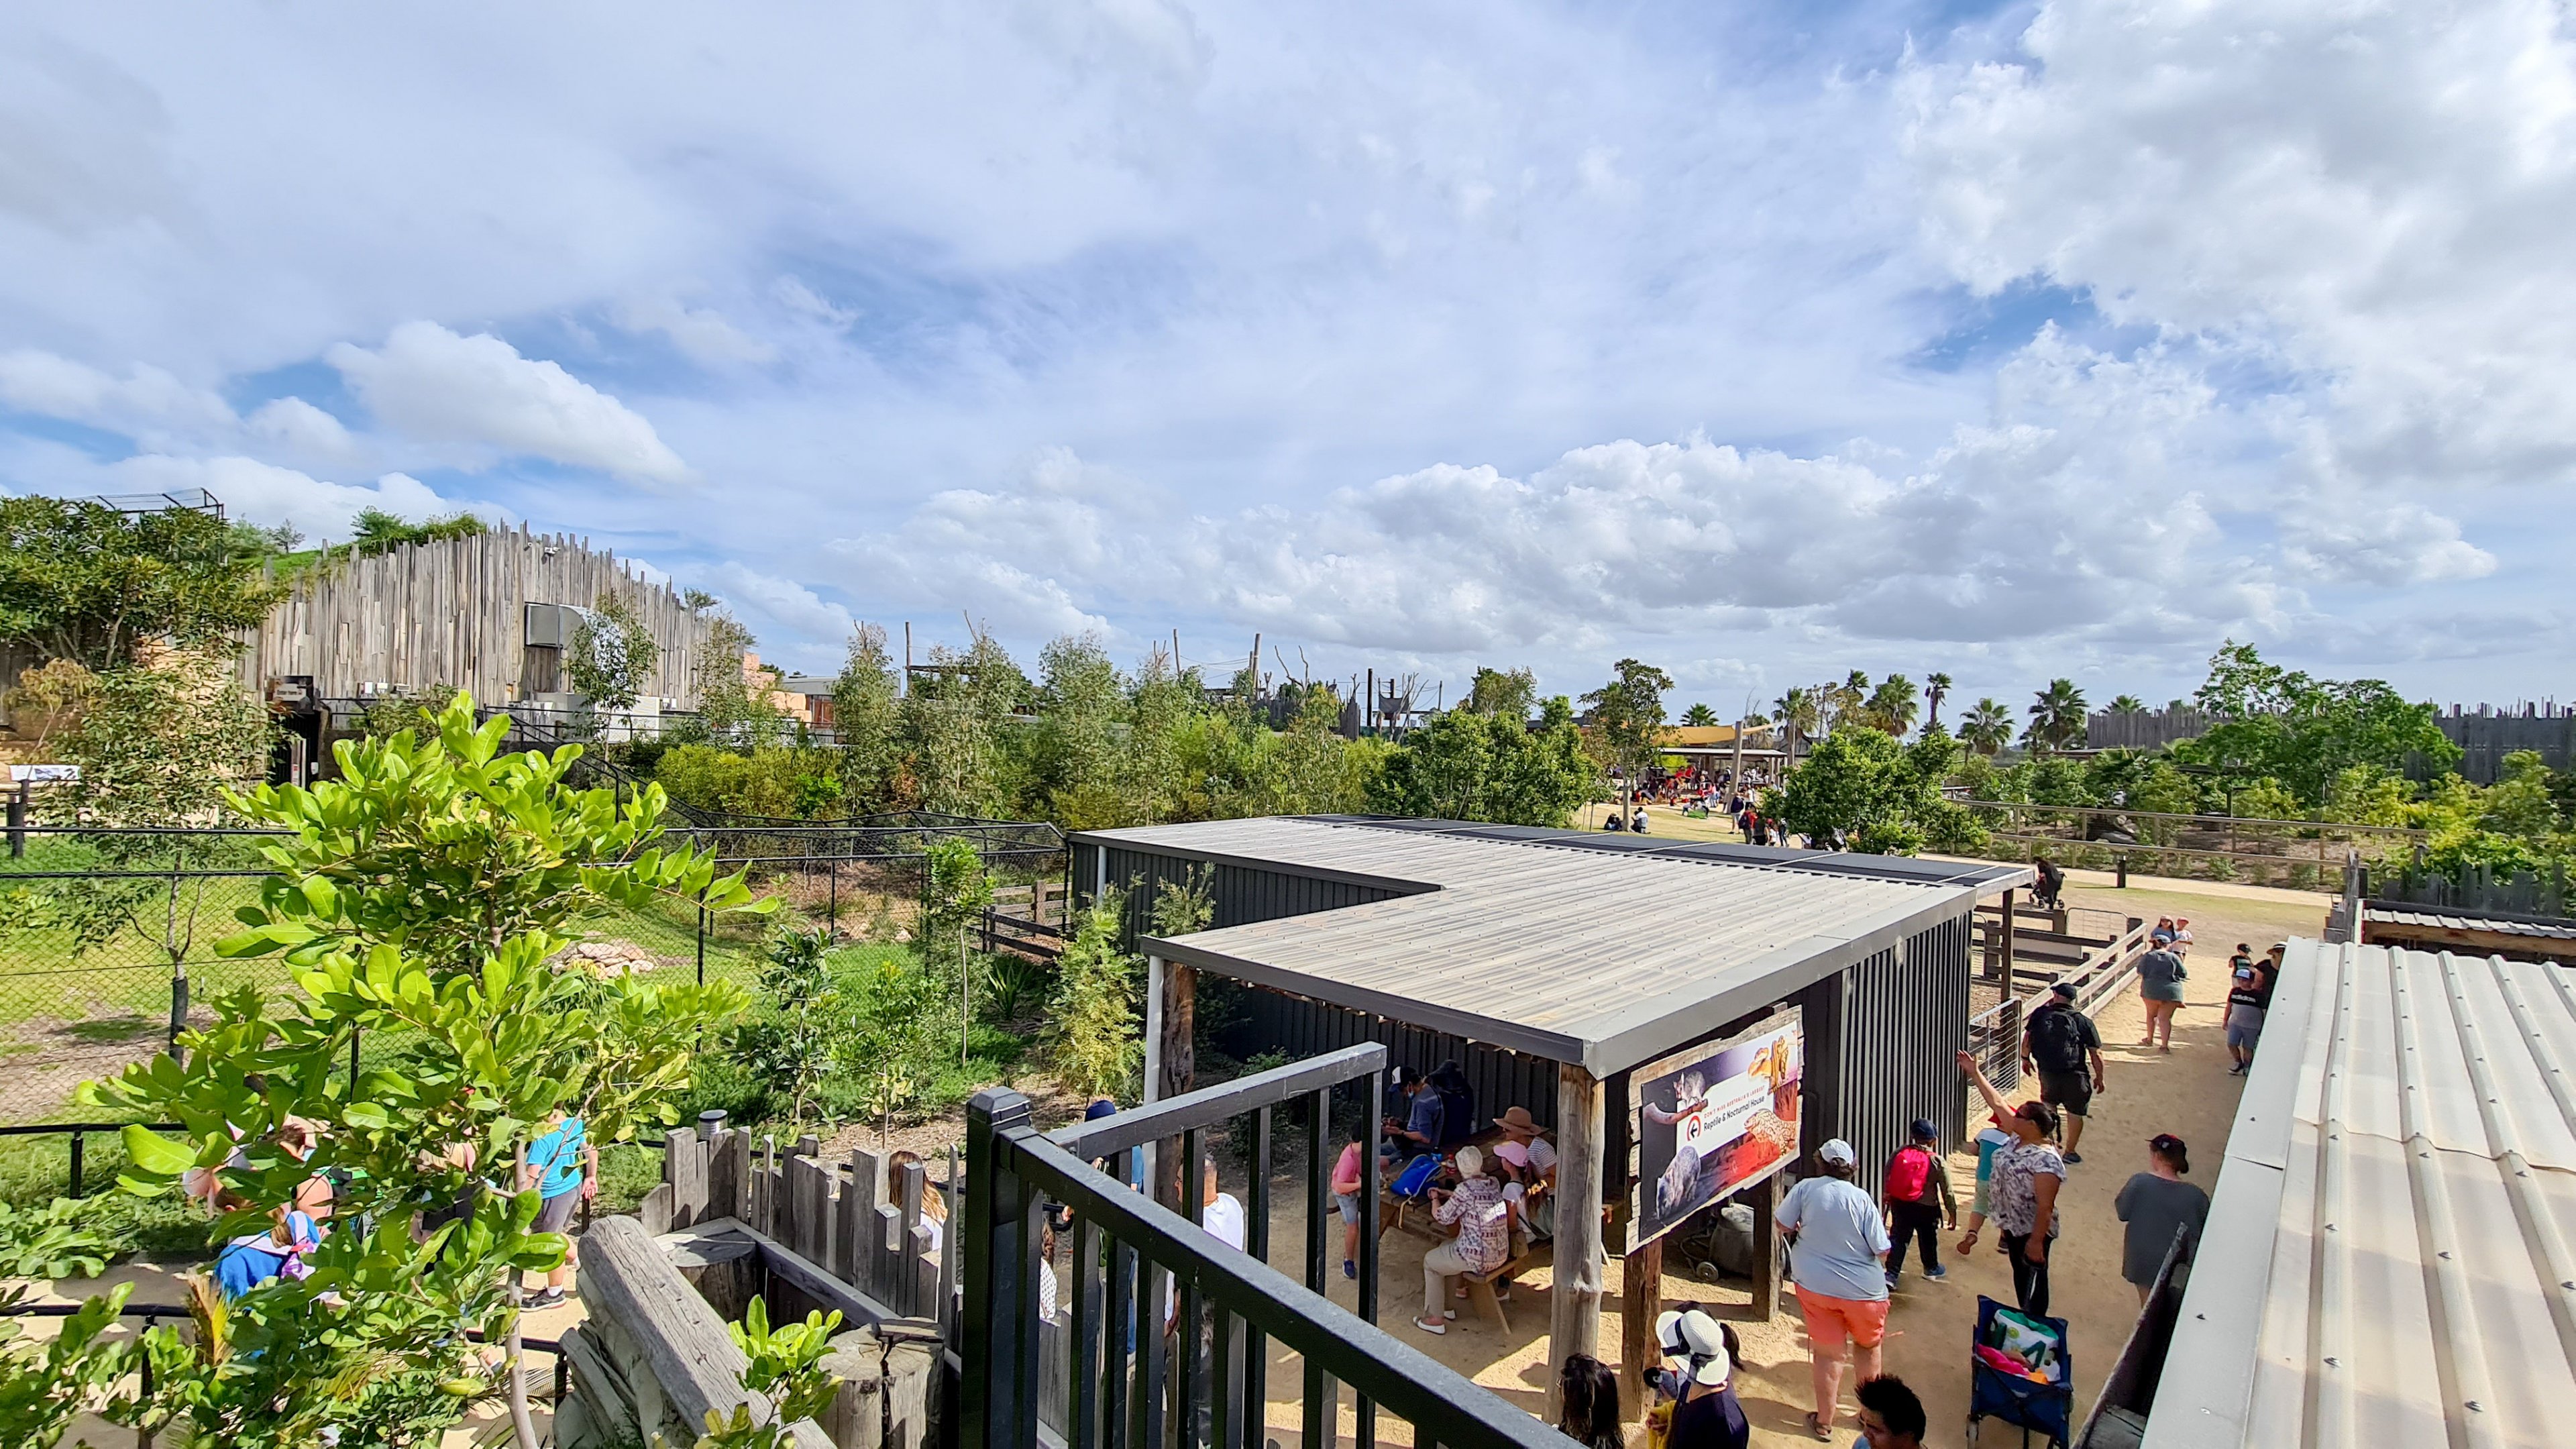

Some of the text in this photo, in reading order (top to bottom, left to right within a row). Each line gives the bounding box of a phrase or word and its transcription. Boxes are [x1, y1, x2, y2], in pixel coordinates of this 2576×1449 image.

[1704, 1108, 1716, 1118] DON'T
[1704, 1095, 1765, 1131] Reptile & Nocturnal House
